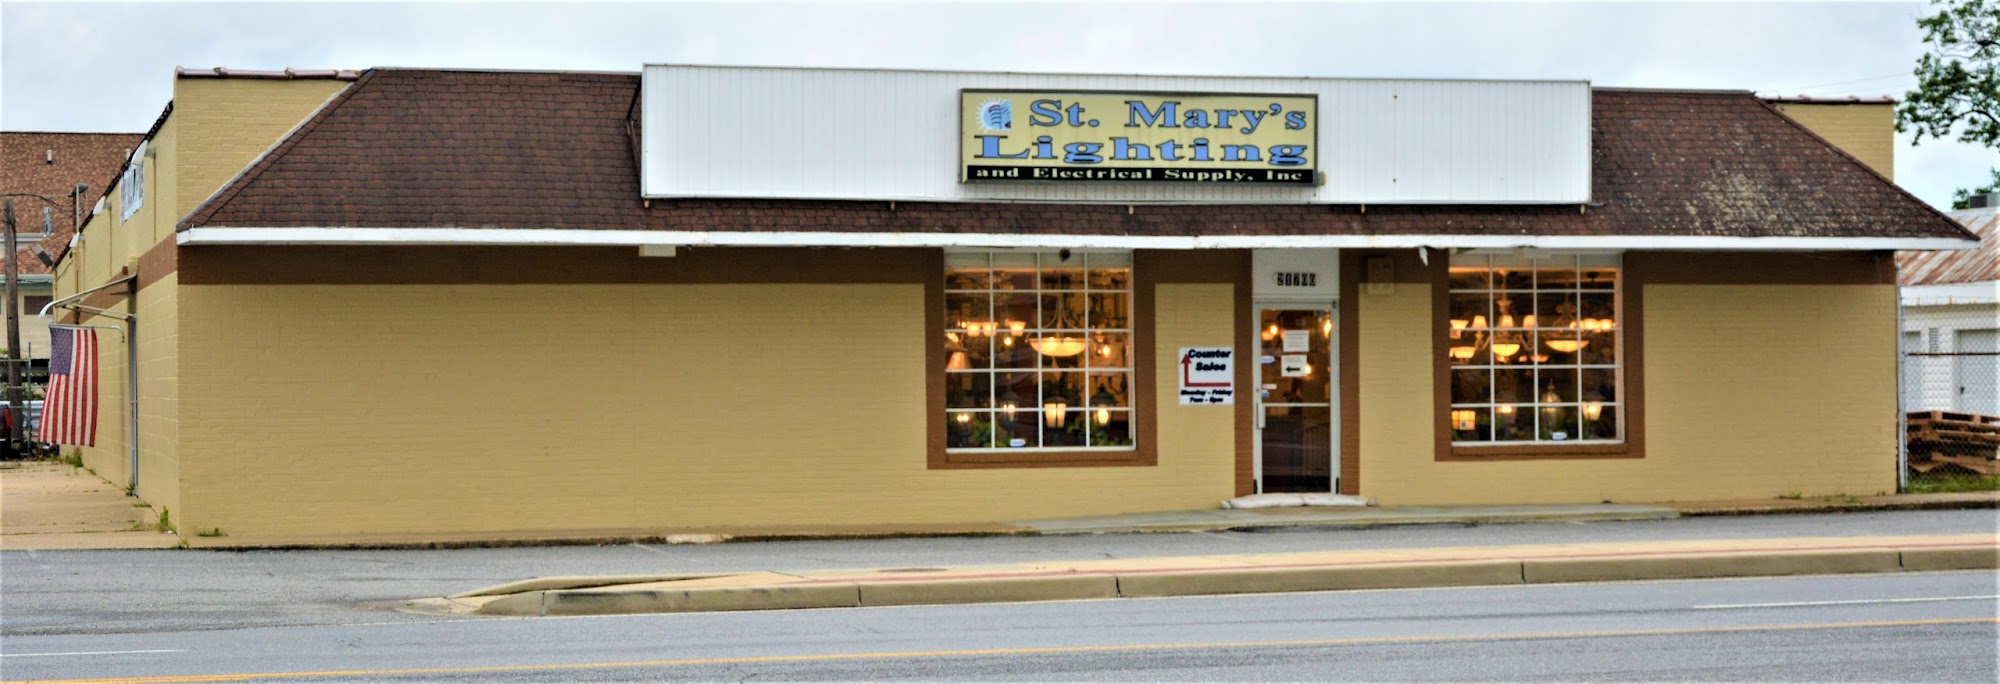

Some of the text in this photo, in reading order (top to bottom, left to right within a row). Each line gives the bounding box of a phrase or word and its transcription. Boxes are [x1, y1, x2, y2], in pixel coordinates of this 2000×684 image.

[1029, 99, 1307, 134] St. Mary's
[973, 135, 1308, 165] Lighting
[976, 167, 1303, 181] and Electrical Supply, Inc
[1188, 349, 1232, 358] Counter
[1195, 362, 1226, 371] Sales
